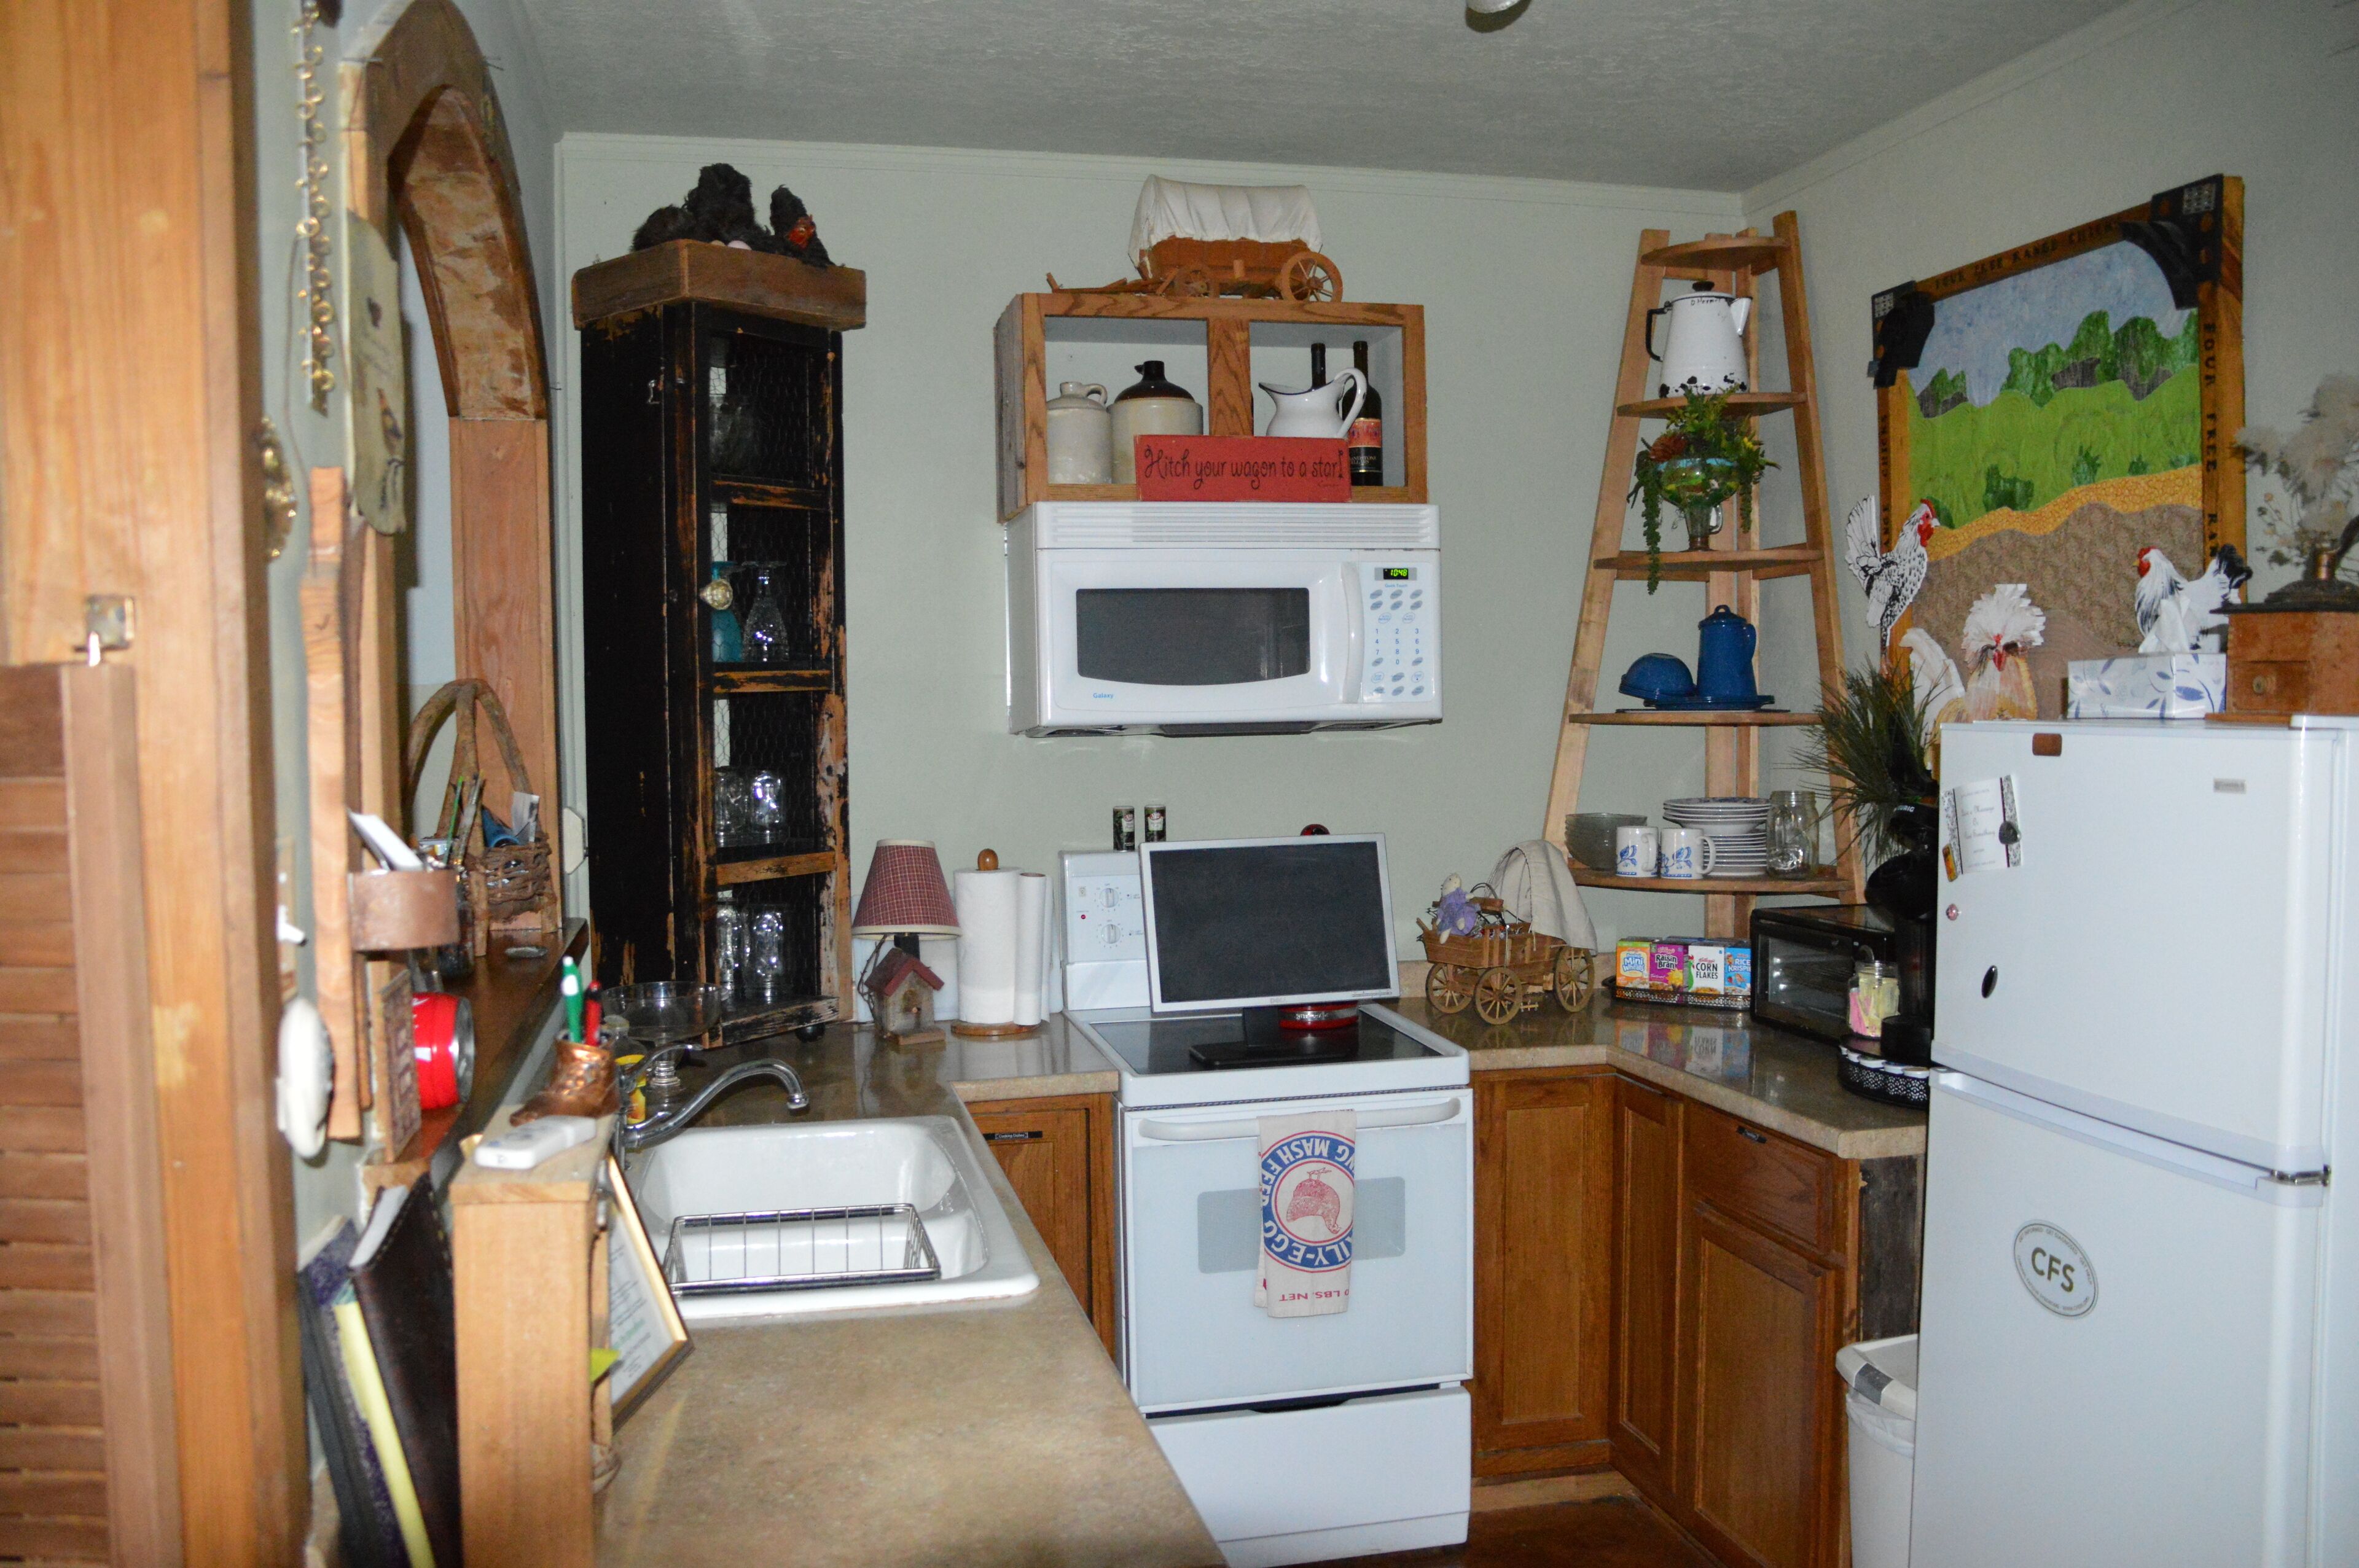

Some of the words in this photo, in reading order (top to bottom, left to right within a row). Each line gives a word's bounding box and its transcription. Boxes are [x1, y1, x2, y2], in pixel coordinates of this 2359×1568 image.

[2206, 413, 2217, 472] FREE
[1144, 445, 1190, 479] Hitch
[1194, 460, 1227, 490] your
[1231, 461, 1277, 490] wagon
[1281, 457, 1294, 477] to
[1299, 461, 1307, 477] a
[1312, 449, 1344, 479] star!
[2207, 512, 2219, 558] RAN
[1624, 957, 1643, 965] Mini
[1656, 954, 1677, 963] Raisin
[1696, 963, 1718, 972] CORN
[1277, 1138, 1329, 1165] MASH
[2032, 1247, 2075, 1292] CFS
[1278, 1293, 1308, 1301] NET
[1312, 1290, 1340, 1298] LBS.
